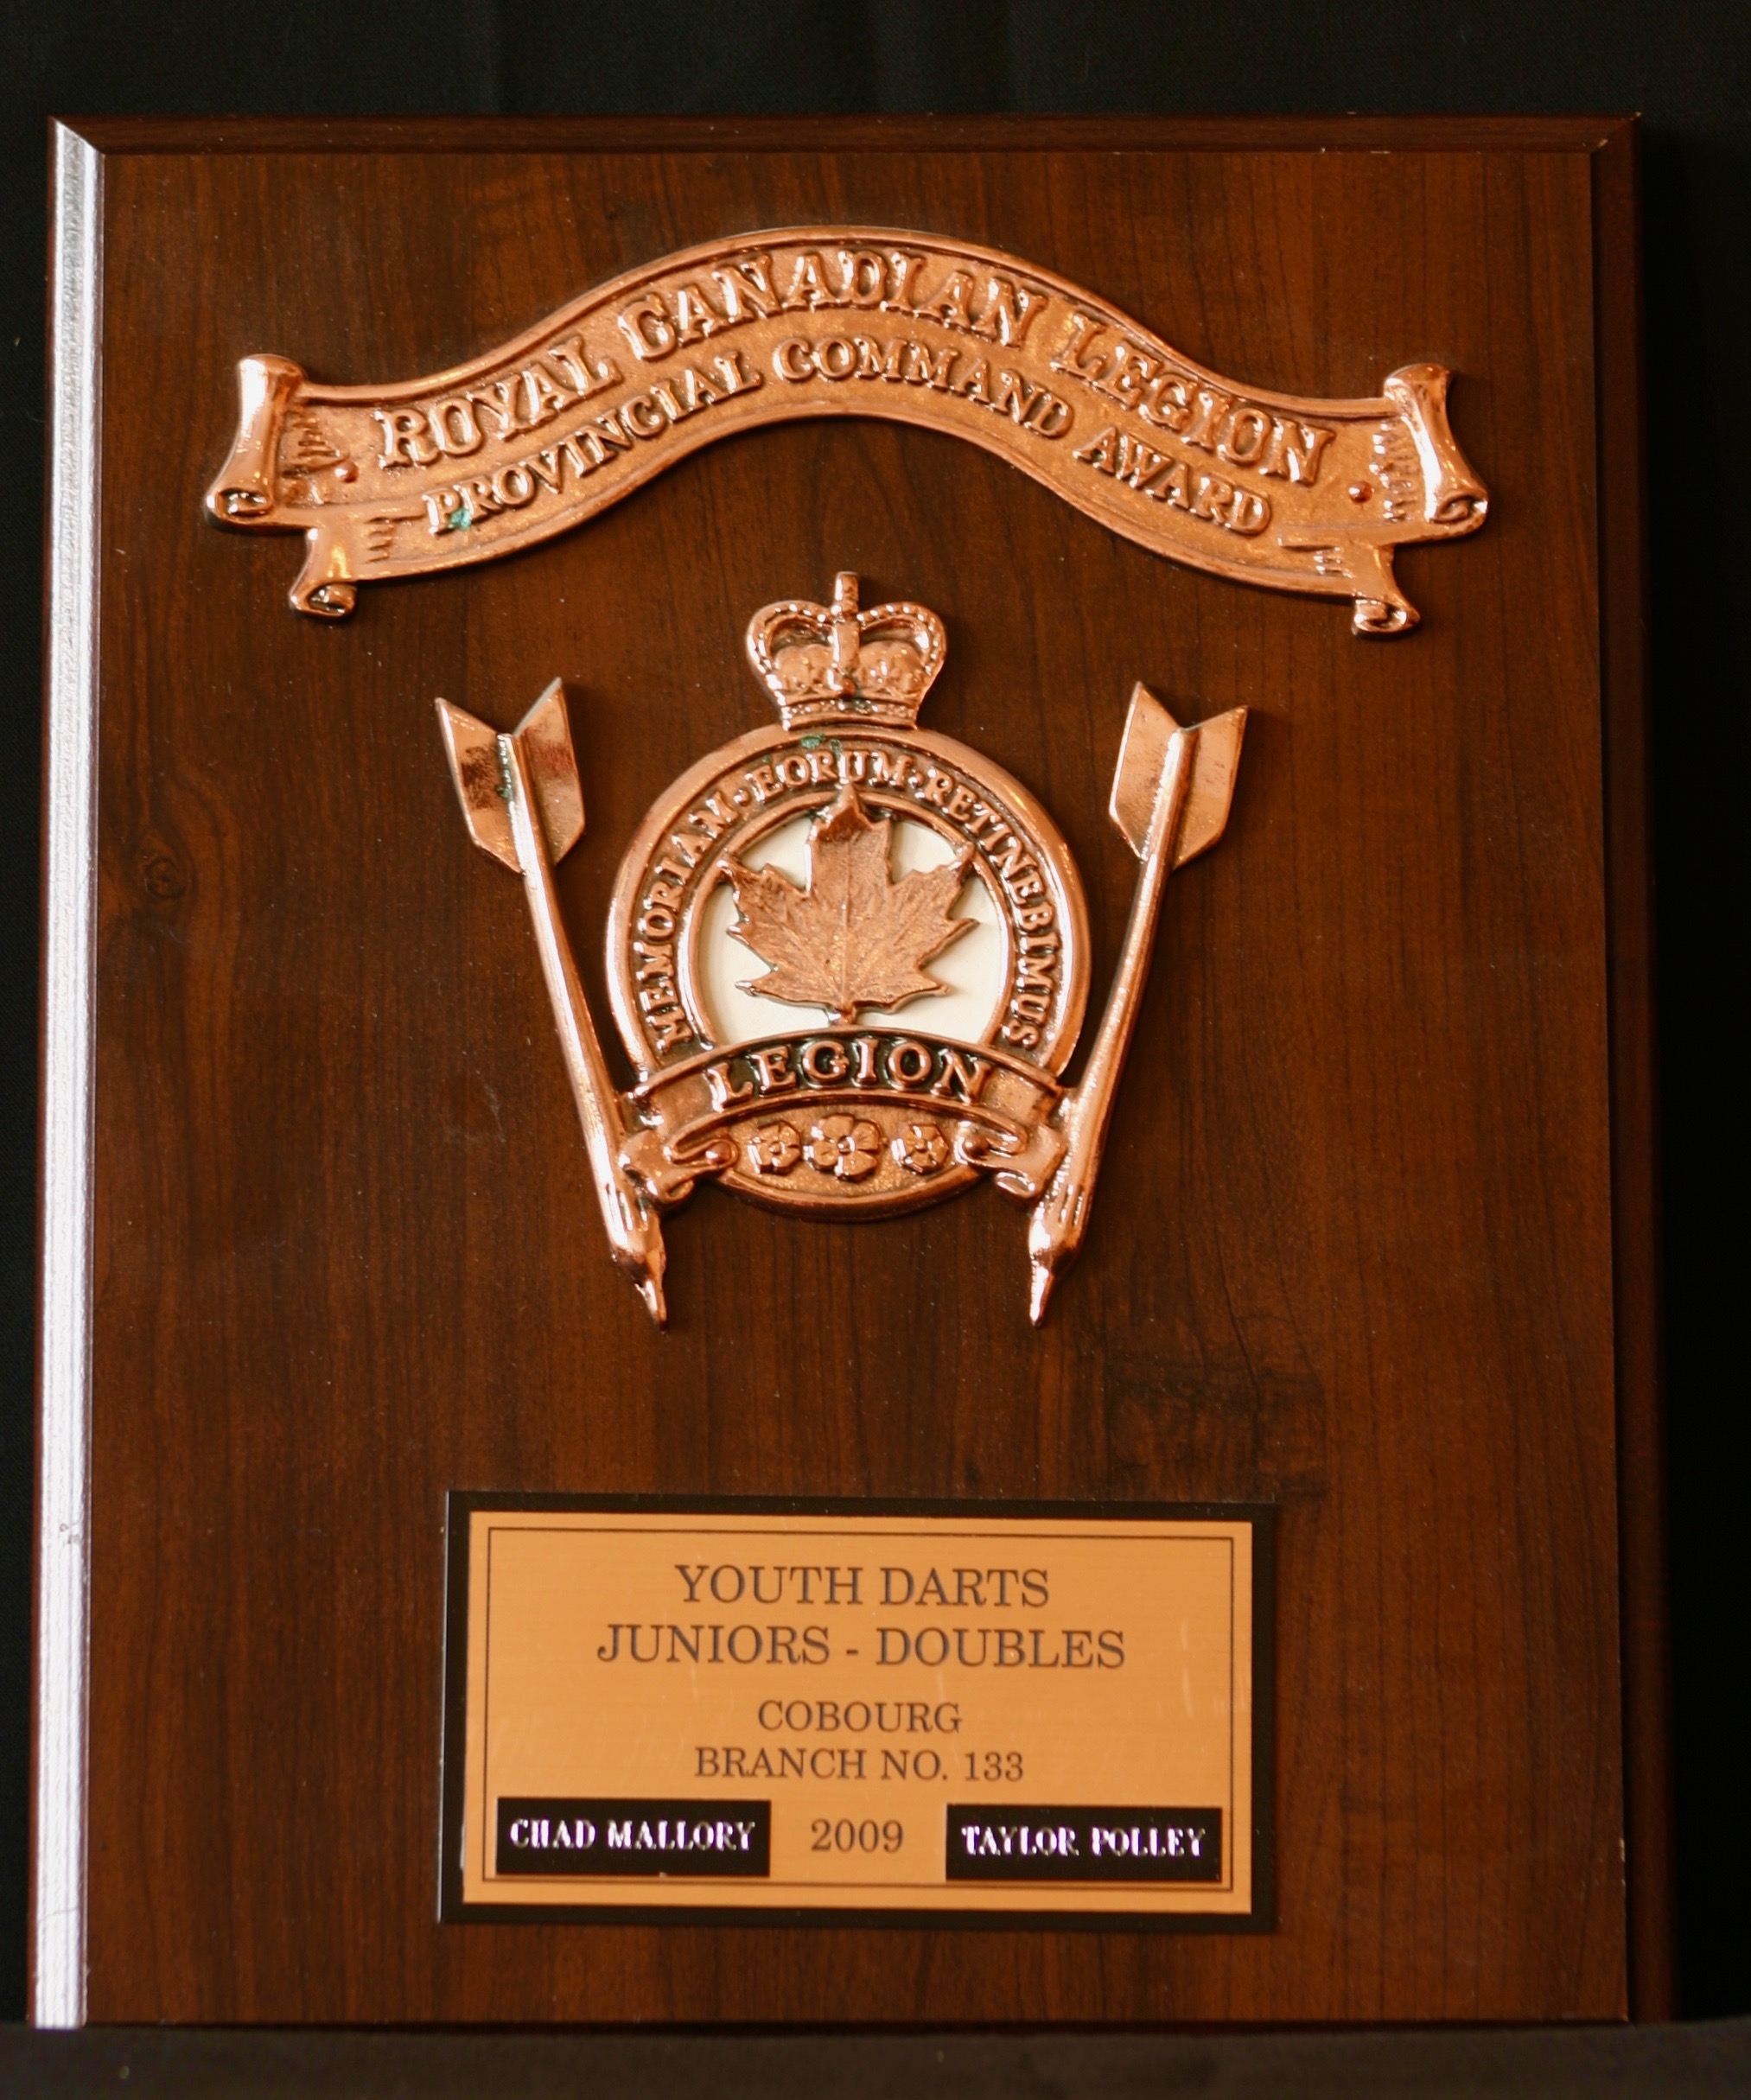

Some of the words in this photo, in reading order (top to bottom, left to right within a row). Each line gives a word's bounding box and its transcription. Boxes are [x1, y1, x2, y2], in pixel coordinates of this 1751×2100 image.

[378, 337, 624, 470] ROYAL
[617, 248, 1048, 361] CANADIAN
[1048, 309, 1337, 487] LEGION
[422, 350, 764, 536] PROVINCIAL
[774, 337, 1075, 439] COMMAND
[1072, 424, 1272, 537] AWARD
[634, 786, 742, 1053] MEMORIAM
[705, 1036, 993, 1113] LEGION
[674, 1563, 864, 1607] YOUTH
[880, 1568, 1051, 1607] DARTS
[596, 1624, 830, 1665] JUNIORS
[876, 1628, 1126, 1670] DOUBLES
[757, 1700, 963, 1734] COBOURG
[694, 1747, 867, 1779] BRANCH
[881, 1750, 949, 1781] NO.
[964, 1753, 1024, 1782] 133
[508, 1818, 596, 1849] CHAD
[607, 1821, 755, 1851] MALLORY
[810, 1819, 904, 1853] 2009
[961, 1825, 1079, 1856] TAYLOR
[1090, 1828, 1207, 1857] POLLEY
